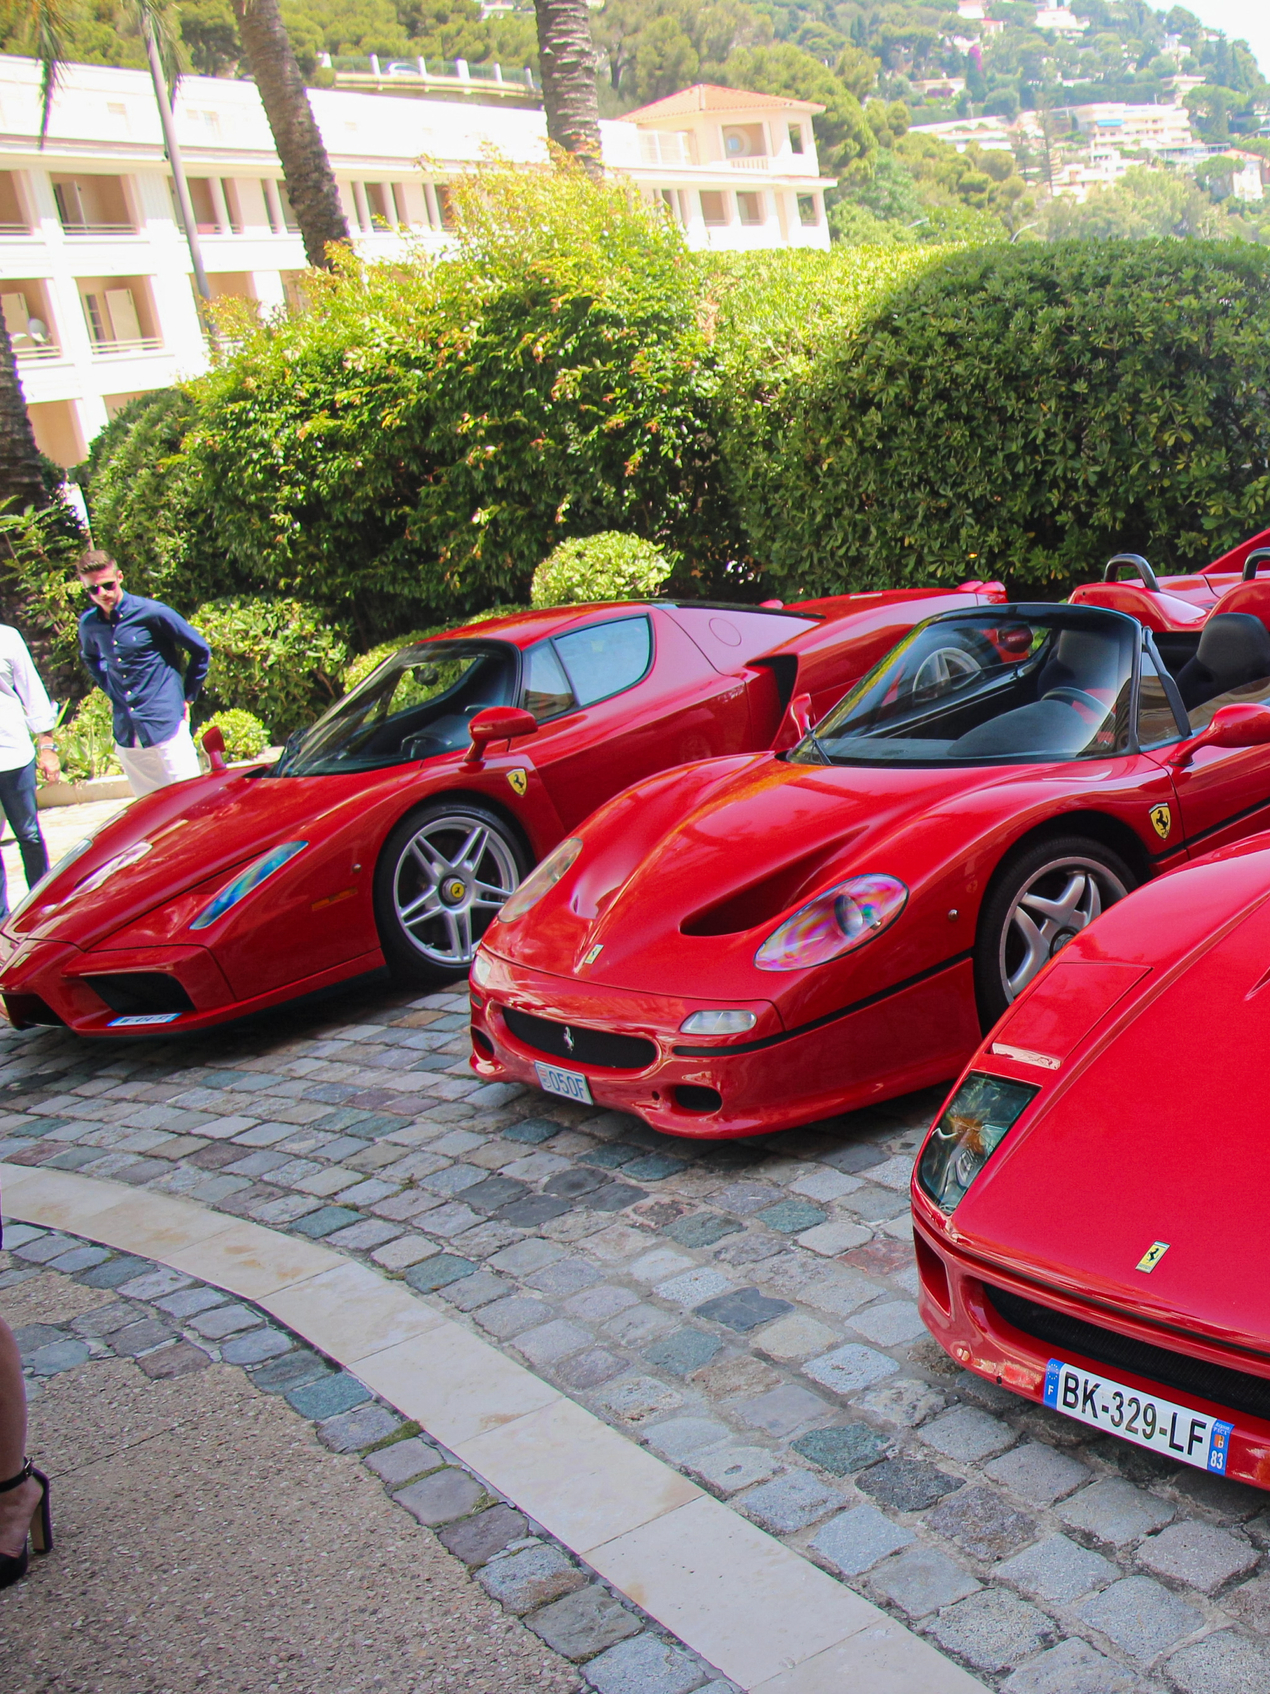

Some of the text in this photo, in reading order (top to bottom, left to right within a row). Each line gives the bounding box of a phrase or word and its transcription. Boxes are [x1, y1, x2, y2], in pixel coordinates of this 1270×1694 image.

[1047, 1385, 1054, 1396] F
[1062, 1371, 1208, 1456] BK-329-LF
[1210, 1450, 1224, 1470] 83
